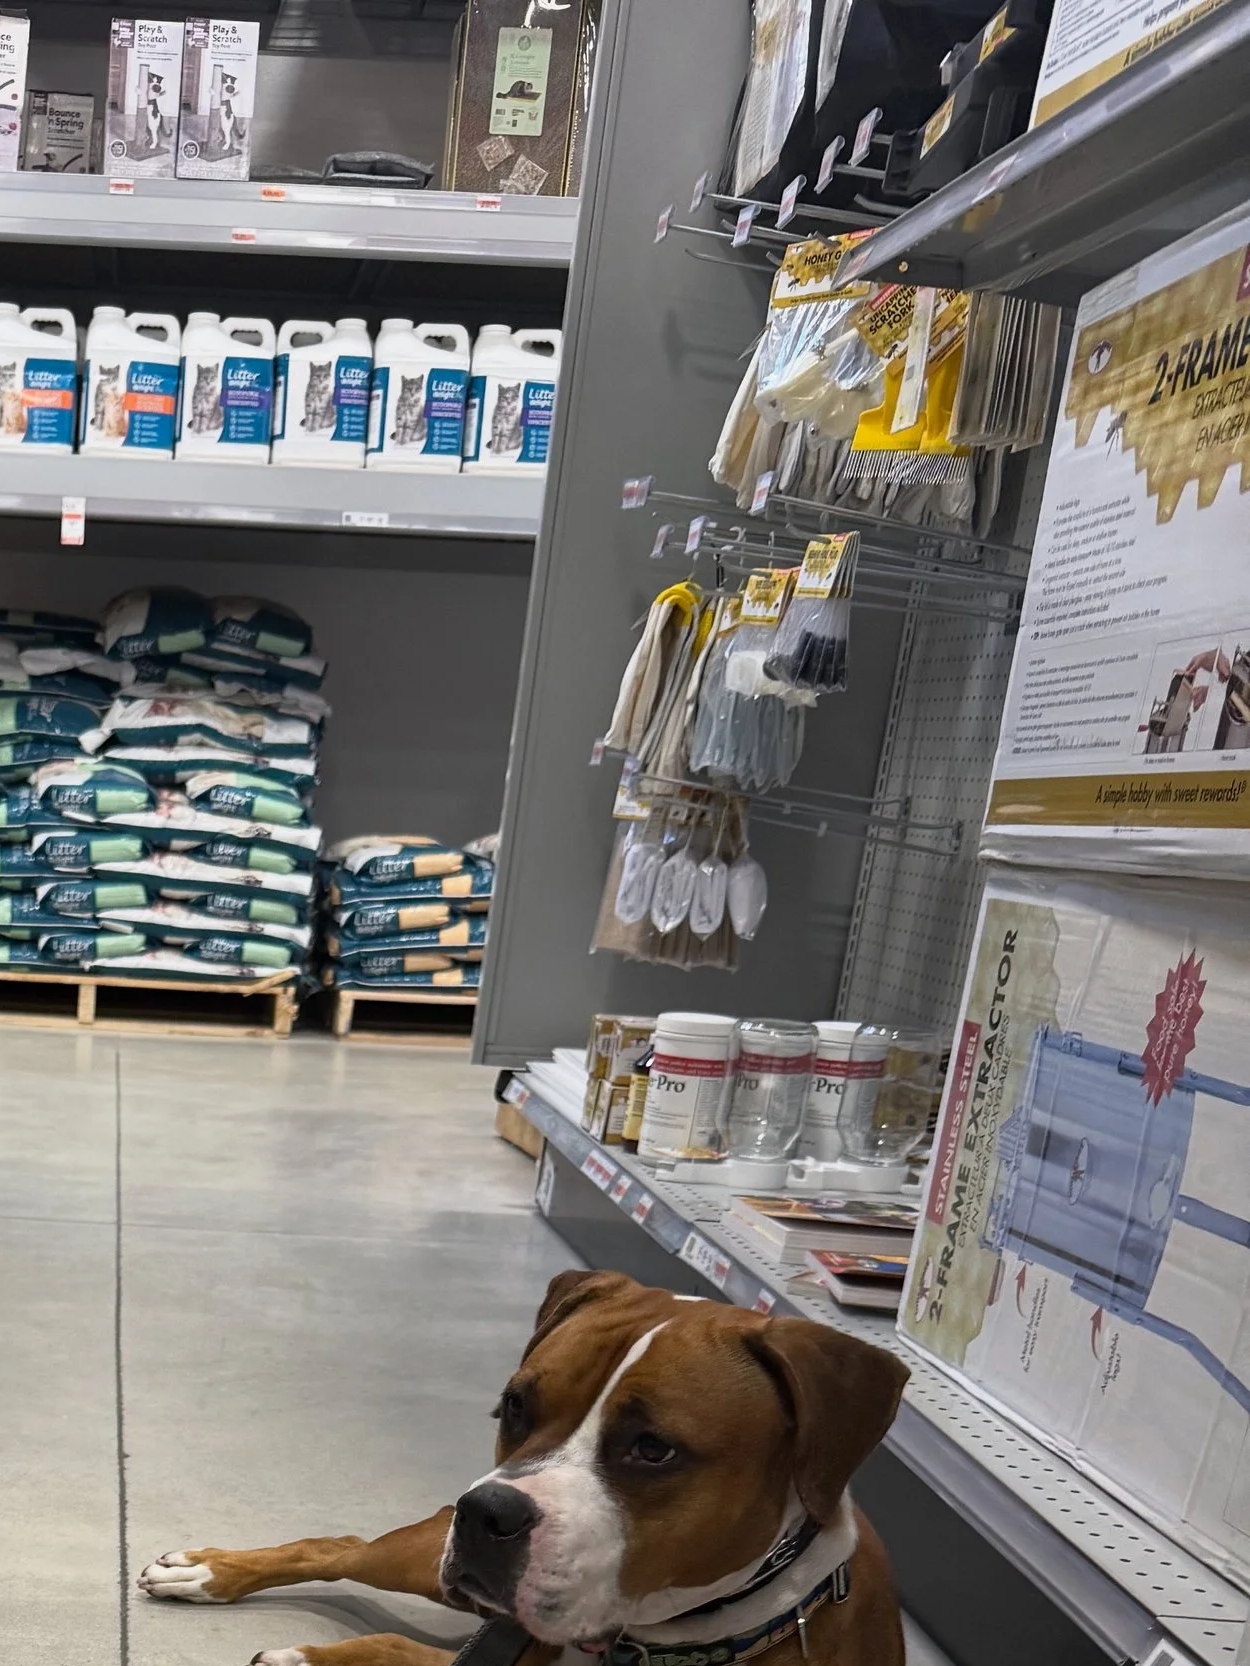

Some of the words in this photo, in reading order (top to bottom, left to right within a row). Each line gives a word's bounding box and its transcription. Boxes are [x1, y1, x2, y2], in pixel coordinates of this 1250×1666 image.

[138, 25, 155, 35] Play
[212, 25, 229, 35] Play
[138, 34, 168, 44] Scratch
[212, 34, 242, 44] Scratch
[49, 107, 81, 118] Bounce
[55, 117, 84, 129] Spring
[804, 251, 834, 266] HONEY
[869, 286, 909, 322] UNCAPPIN
[869, 285, 917, 335] SCRATCHE
[887, 303, 915, 330] FORK
[28, 369, 61, 382] Litter
[131, 373, 164, 386] Litter
[227, 368, 260, 382] Litter
[339, 367, 369, 381] Litter
[432, 380, 464, 393] Litter
[1095, 786, 1103, 803] A
[1104, 781, 1128, 805] simple
[1129, 781, 1153, 808] hobby
[1154, 782, 1173, 801] with
[1173, 785, 1199, 802] sweet
[1174, 978, 1190, 1014] best
[1151, 1016, 1168, 1060] Food
[1164, 1043, 1179, 1083] pure
[1176, 980, 1198, 1040] honey!
[928, 1163, 971, 1324] 2-FRAME
[963, 929, 1019, 1152] EXTRACTOR
[934, 1100, 964, 1216] STAINLESS
[959, 1032, 978, 1092] STEEL
